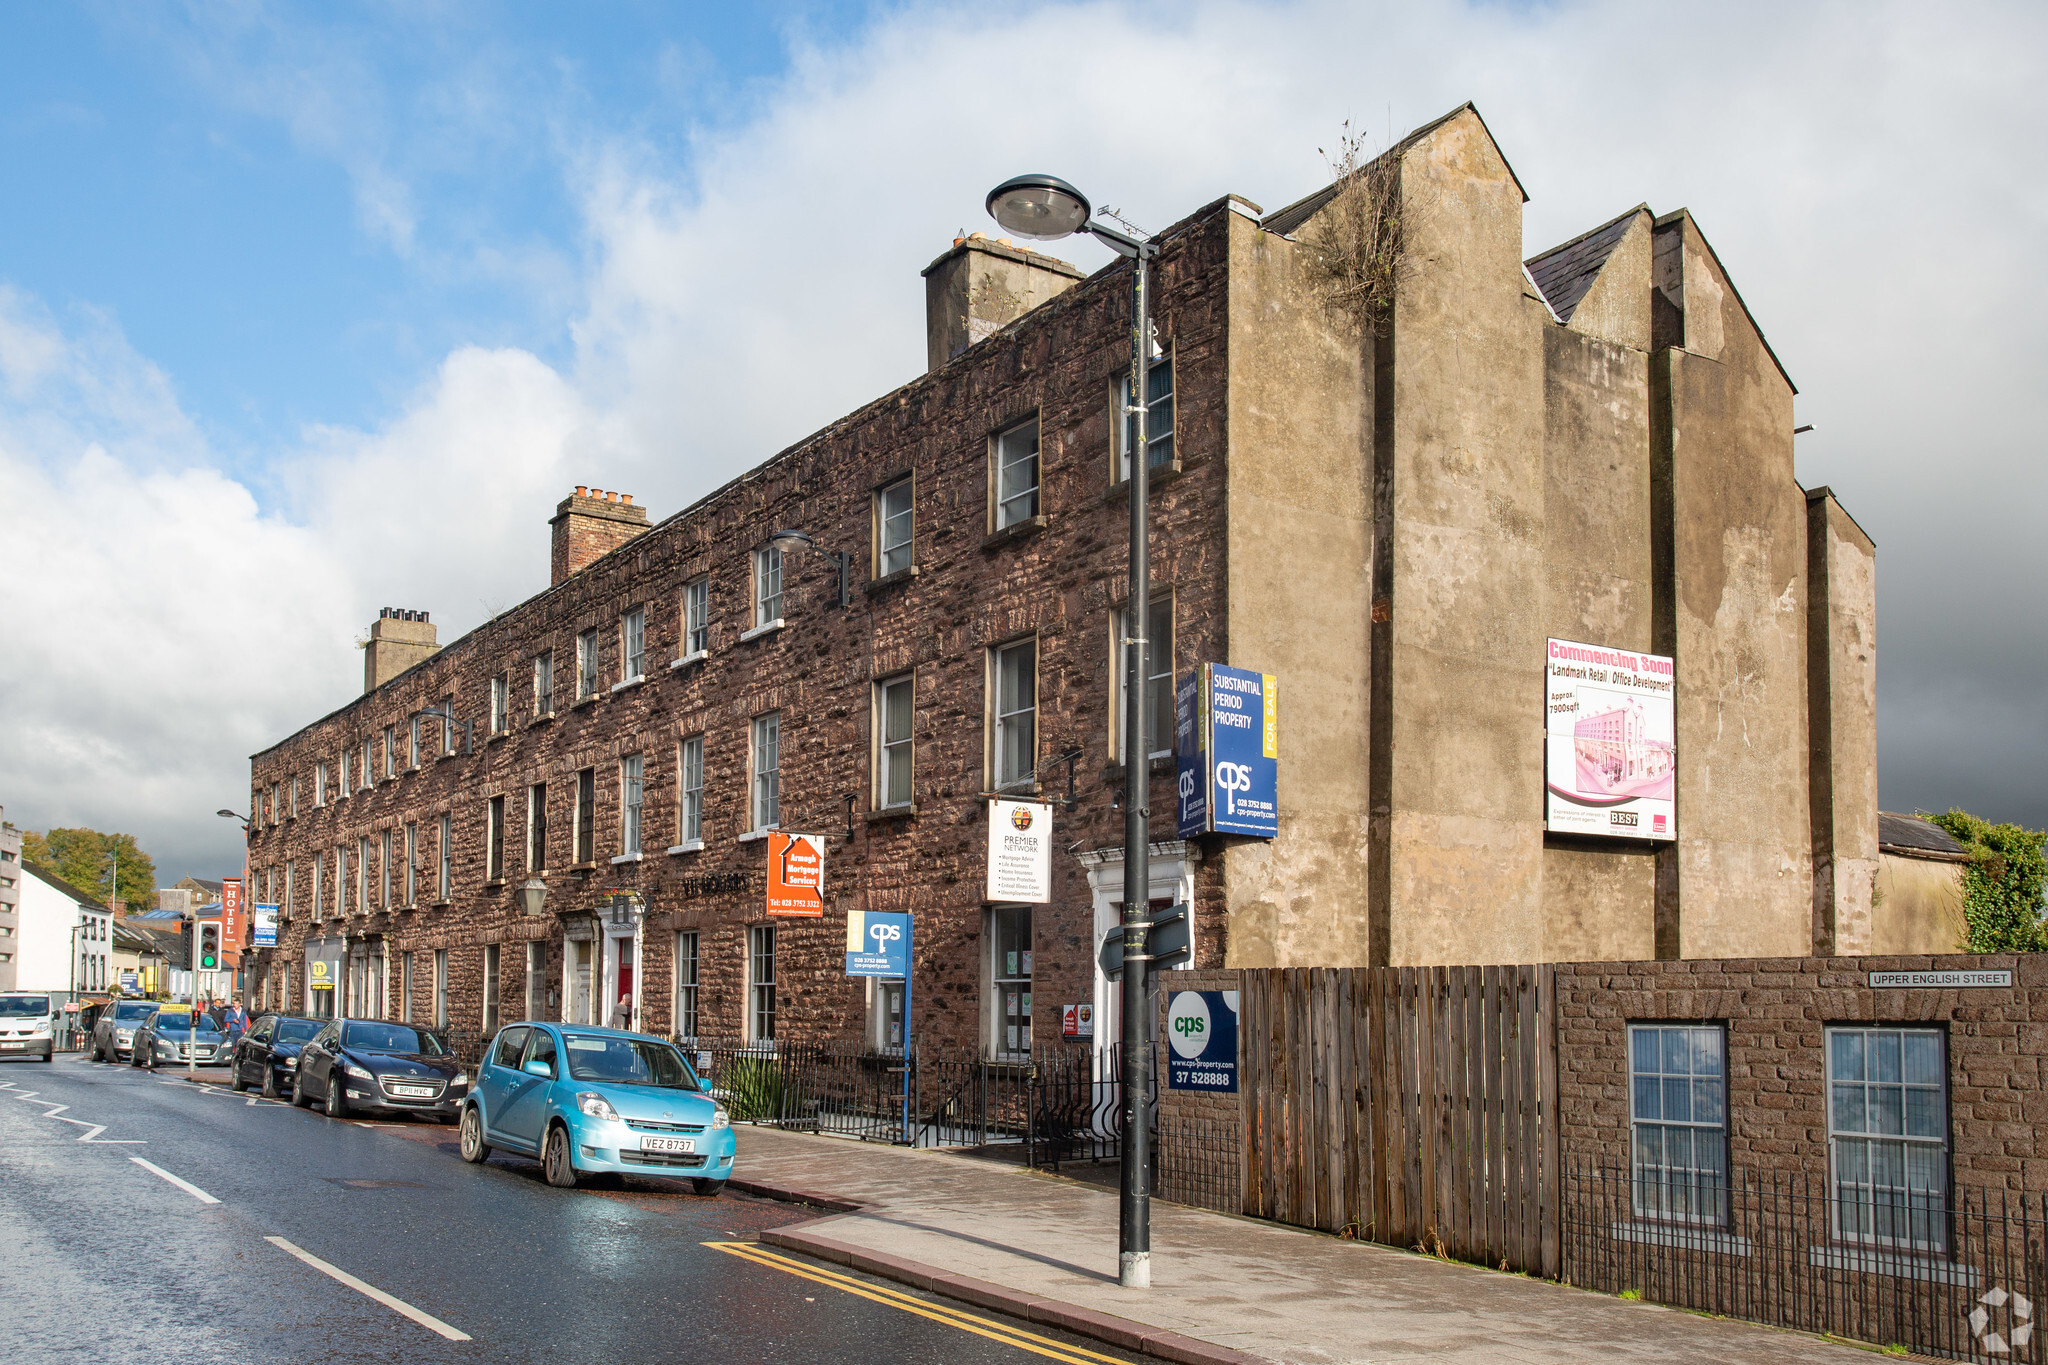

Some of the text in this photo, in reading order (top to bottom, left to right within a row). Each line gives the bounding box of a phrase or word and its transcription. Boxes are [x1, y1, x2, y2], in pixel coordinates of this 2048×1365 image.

[1549, 641, 1672, 675] Commencing Soon
[1589, 668, 1607, 682] Retail
[1612, 671, 1631, 686] Office
[1214, 674, 1261, 696] SUBSTANTIAL
[1178, 681, 1197, 705] SUBSTANTIAL
[1551, 692, 1575, 701] Approx.
[1214, 692, 1242, 710] PERIOD
[1549, 702, 1579, 714] 7900sqft
[1178, 704, 1188, 721] PERIOD
[1215, 711, 1251, 729] PROPERTY
[1178, 718, 1192, 738] PROPERTY
[1216, 761, 1250, 815] cps
[1237, 799, 1272, 810] 028 3752 8888
[1237, 808, 1275, 819] cps-property.com
[1611, 812, 1637, 825] BEST
[1005, 836, 1038, 846] PREMIER
[790, 854, 816, 864] Armagh
[787, 865, 818, 875] Mortgage
[790, 876, 816, 885] Services
[227, 891, 236, 934] HOTEL
[870, 924, 900, 953] cps
[1874, 974, 2007, 984] UPPER ENGLISH STREET
[1175, 1017, 1204, 1037] cps
[1176, 1071, 1229, 1085] 37 528888
[646, 1139, 691, 1150] VEZ 8737
